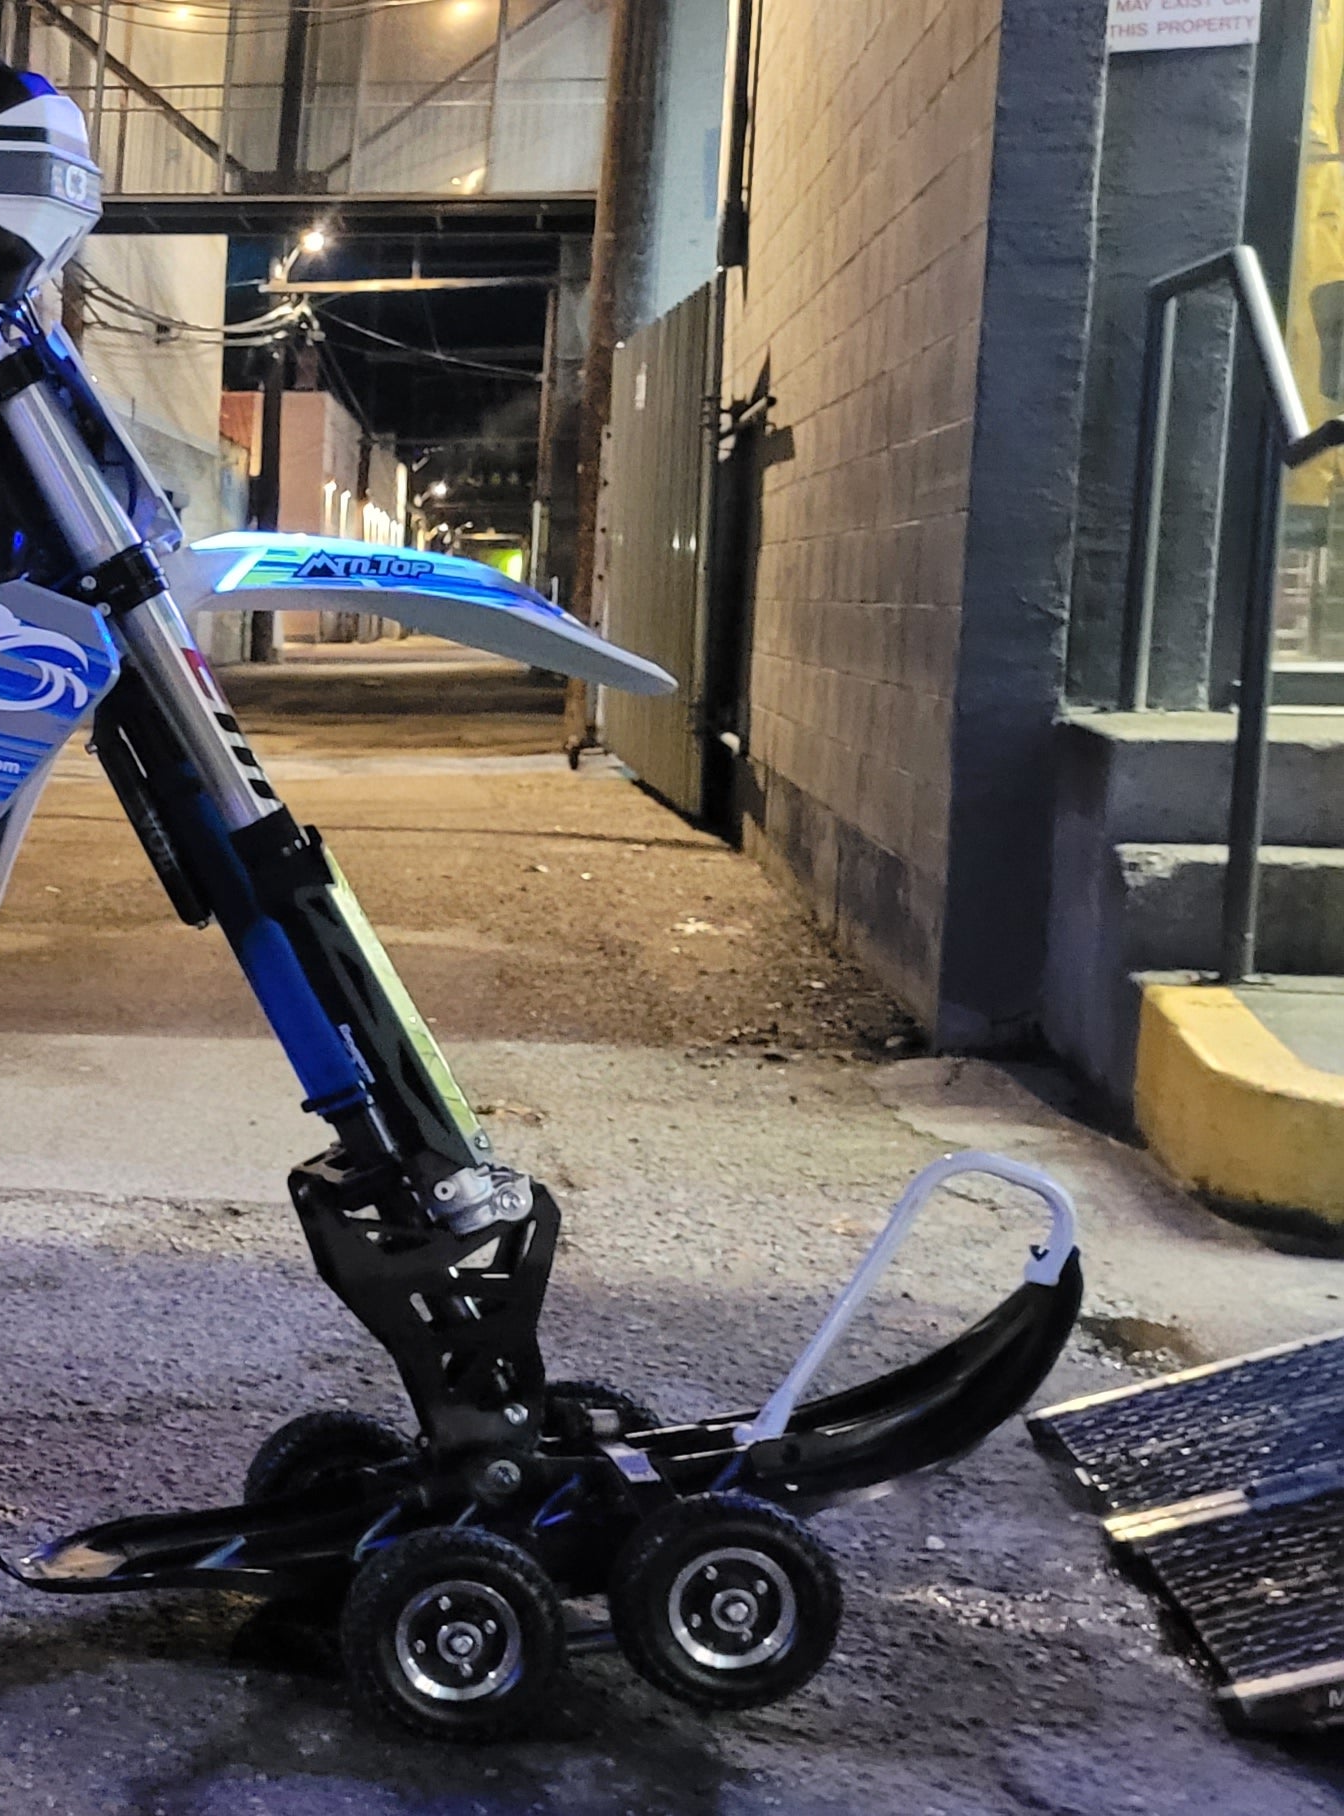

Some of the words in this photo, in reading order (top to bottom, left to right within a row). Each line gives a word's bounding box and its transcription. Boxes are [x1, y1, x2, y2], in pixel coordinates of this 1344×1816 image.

[1116, 0, 1150, 12] MAY
[1110, 22, 1148, 38] THIS
[1157, 15, 1255, 34] PROPERTY
